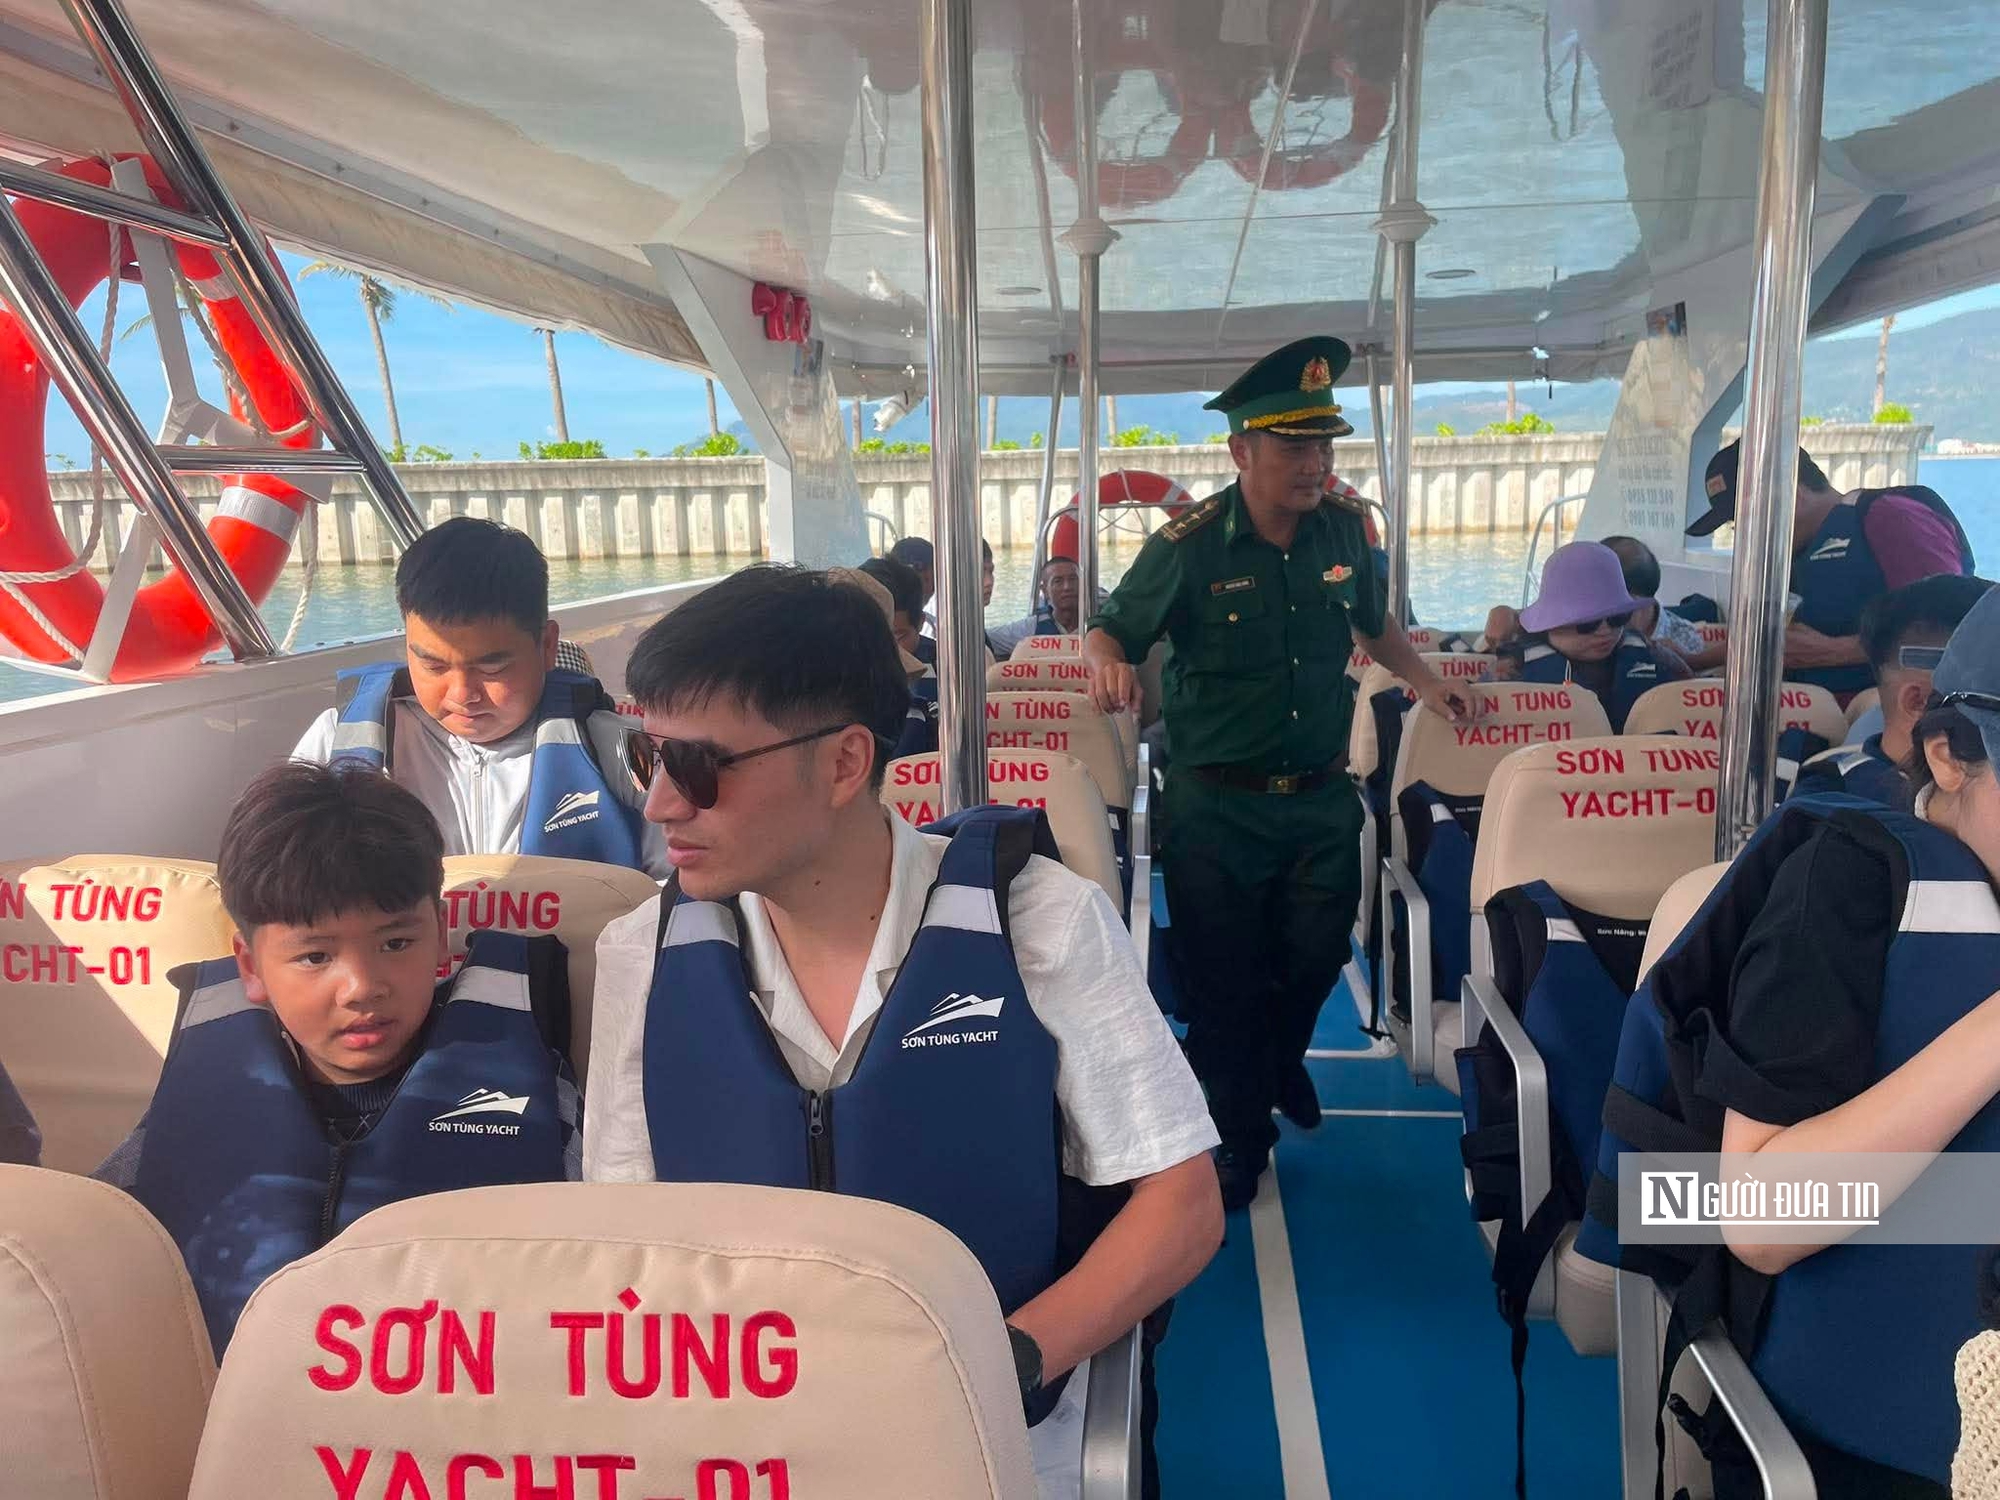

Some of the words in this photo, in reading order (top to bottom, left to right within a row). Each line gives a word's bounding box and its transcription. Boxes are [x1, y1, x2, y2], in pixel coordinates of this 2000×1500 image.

[1012, 698, 1071, 720] TÙNG
[1780, 690, 1812, 708] NG
[1454, 721, 1572, 746] YACHT-01
[988, 759, 1049, 783] ÙNG
[1556, 747, 1625, 775] SƠN
[1560, 787, 1716, 818] YACHT-0
[442, 881, 560, 930] TÙNG
[902, 1036, 926, 1048] SƠN
[927, 1033, 960, 1045] TÙNG
[961, 1031, 998, 1043] YACHT
[428, 1121, 451, 1132] SƠN
[452, 1122, 484, 1134] TÙNG
[485, 1124, 520, 1136] YACHT
[307, 1299, 496, 1395] SƠN
[550, 1287, 799, 1400] TÙNG
